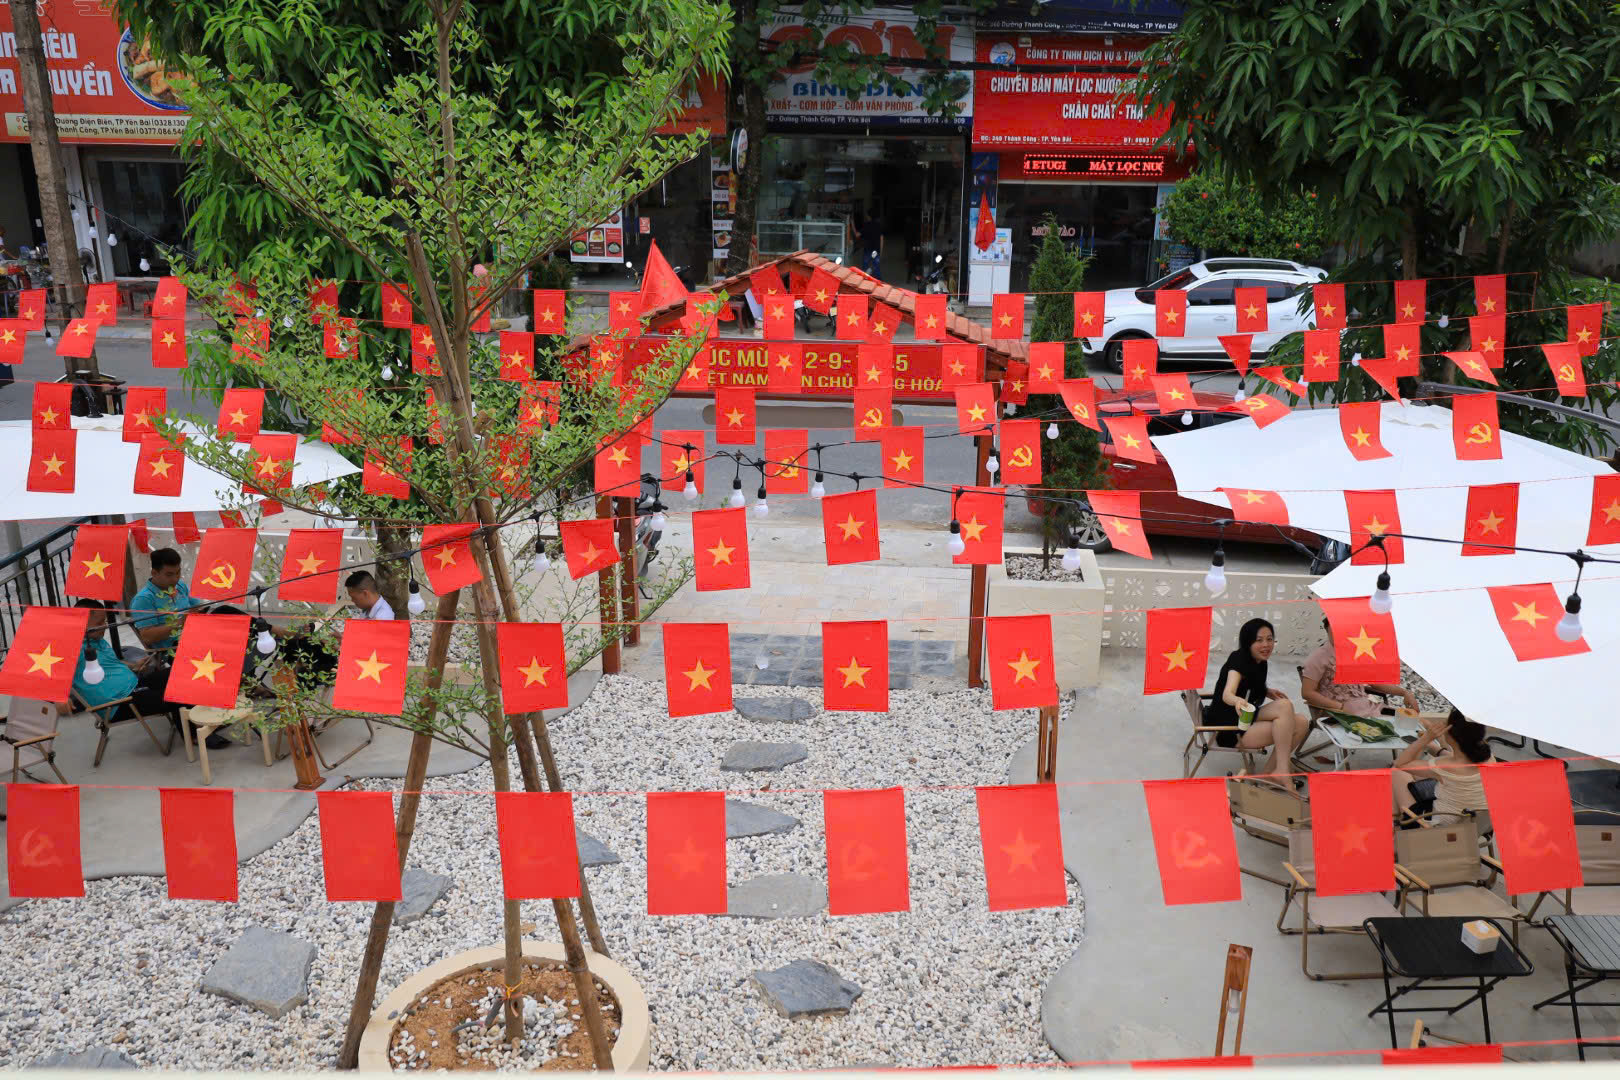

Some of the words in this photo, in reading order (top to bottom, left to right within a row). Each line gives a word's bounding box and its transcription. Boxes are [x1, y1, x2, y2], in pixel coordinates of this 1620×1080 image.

[40, 27, 78, 59] IÊU
[1026, 46, 1048, 60] CÔNG
[1050, 49, 1060, 60] TY
[1062, 49, 1082, 60] TNHH
[1084, 49, 1102, 63] DỊCH
[1104, 50, 1115, 63] VỤ
[50, 61, 114, 96] UYỀN
[990, 75, 1029, 93] CHUYÊN
[1031, 75, 1052, 93] BÁN
[1053, 75, 1074, 93] MÁY
[1075, 77, 1094, 97] LỌC
[1062, 100, 1089, 119] CHÂN
[1091, 99, 1117, 119] CHẤT
[1032, 160, 1066, 170] ETUGI
[1089, 160, 1116, 171] MÁY
[1117, 161, 1140, 173] LỌC
[818, 372, 854, 388] CHỦ
